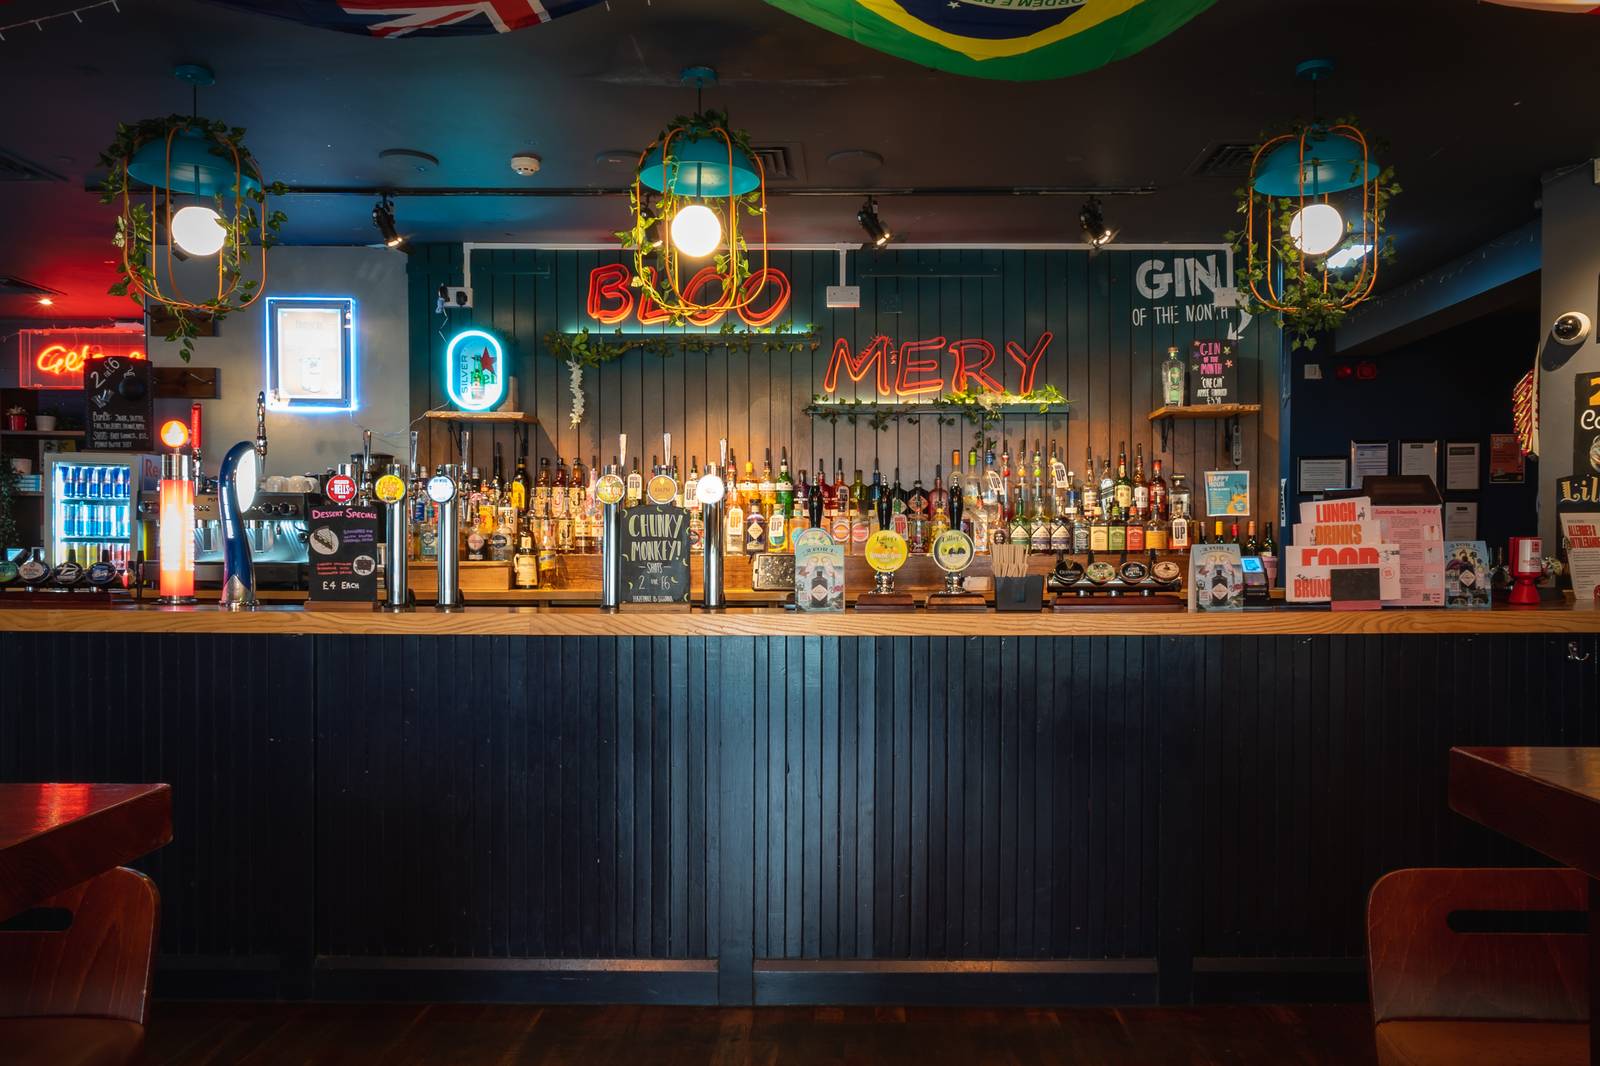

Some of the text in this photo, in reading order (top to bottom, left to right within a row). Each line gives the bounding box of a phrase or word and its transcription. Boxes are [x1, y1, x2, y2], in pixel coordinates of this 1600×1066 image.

[1136, 255, 1221, 299] GIN
[588, 264, 790, 326] BLOO
[1132, 307, 1147, 326] OF
[1153, 305, 1180, 325] THE
[1200, 342, 1220, 355] GIN
[824, 332, 1052, 396] MERY
[1200, 364, 1223, 375] MONTH
[90, 371, 106, 388] 2
[461, 354, 469, 394] SILVER
[1056, 469, 1066, 482] UP
[1560, 476, 1600, 503] Lil
[312, 508, 377, 519] DESSERT SPECIALS
[1316, 502, 1356, 523] LUNCH
[629, 514, 683, 538] CHUNKY
[771, 521, 782, 532] UP
[1174, 526, 1185, 539] UP
[1314, 525, 1362, 545] DRINKS
[631, 541, 681, 561] MONKEY!
[1302, 547, 1379, 566] FOOD
[646, 562, 662, 574] SHOTS
[322, 581, 360, 590] £4 EACH
[639, 575, 646, 589] 2
